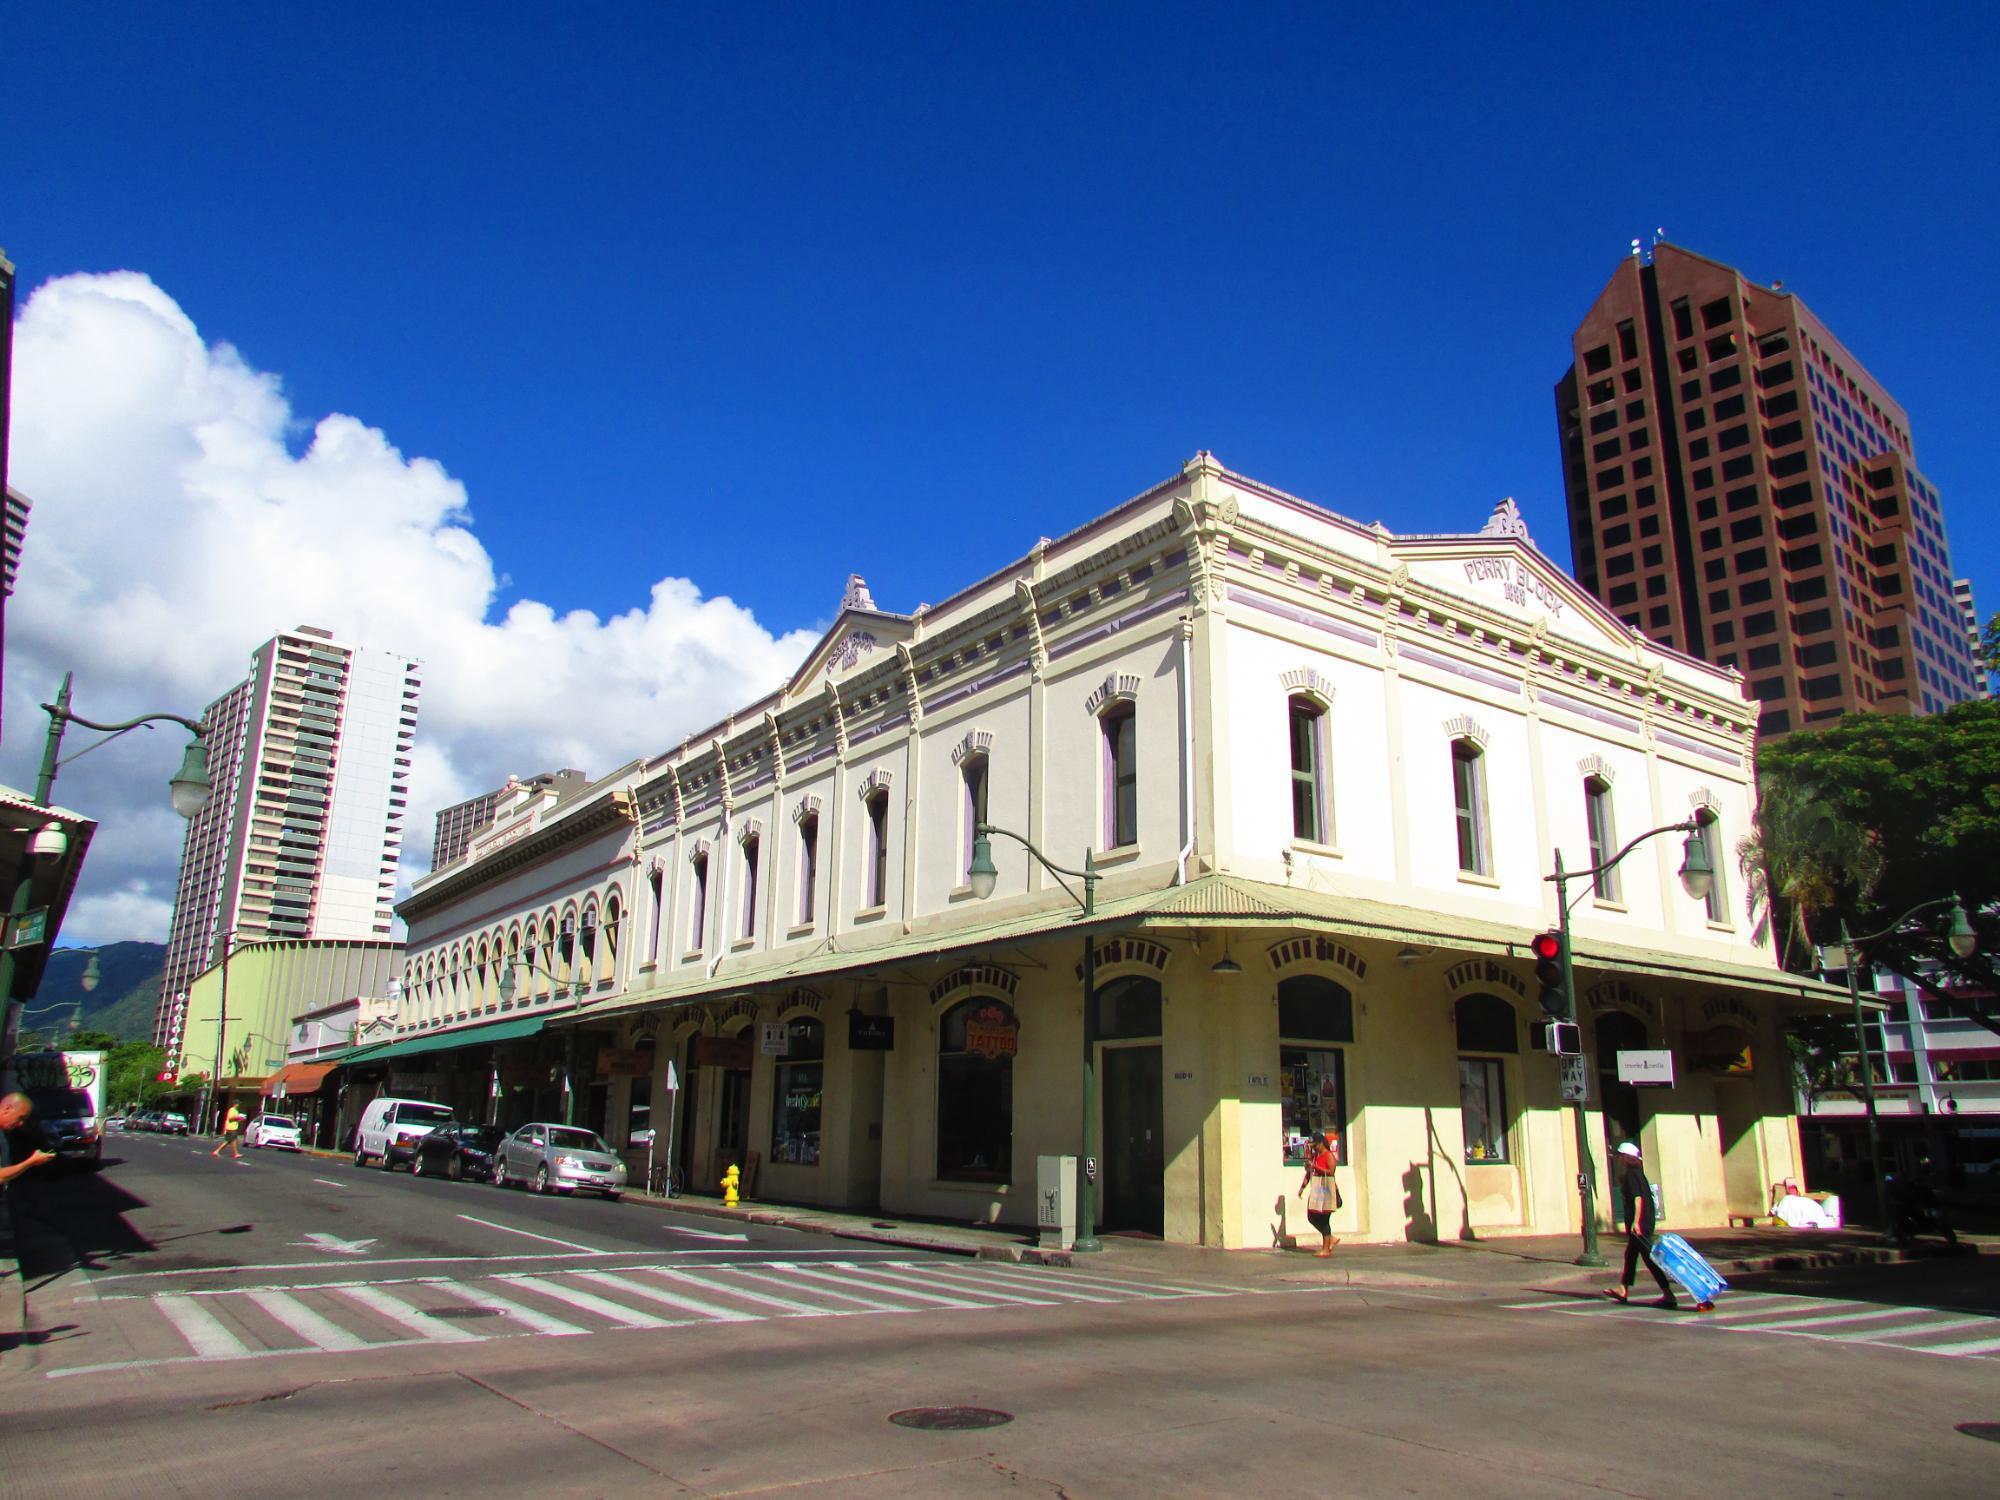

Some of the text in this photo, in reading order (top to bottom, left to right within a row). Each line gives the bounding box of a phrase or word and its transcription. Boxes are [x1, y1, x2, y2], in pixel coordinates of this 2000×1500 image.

[1464, 558, 1563, 619] PERRY BLOCK
[968, 1033, 1014, 1050] TATTOO
[1561, 1057, 1582, 1069] ONE
[1563, 1072, 1583, 1082] WAY
